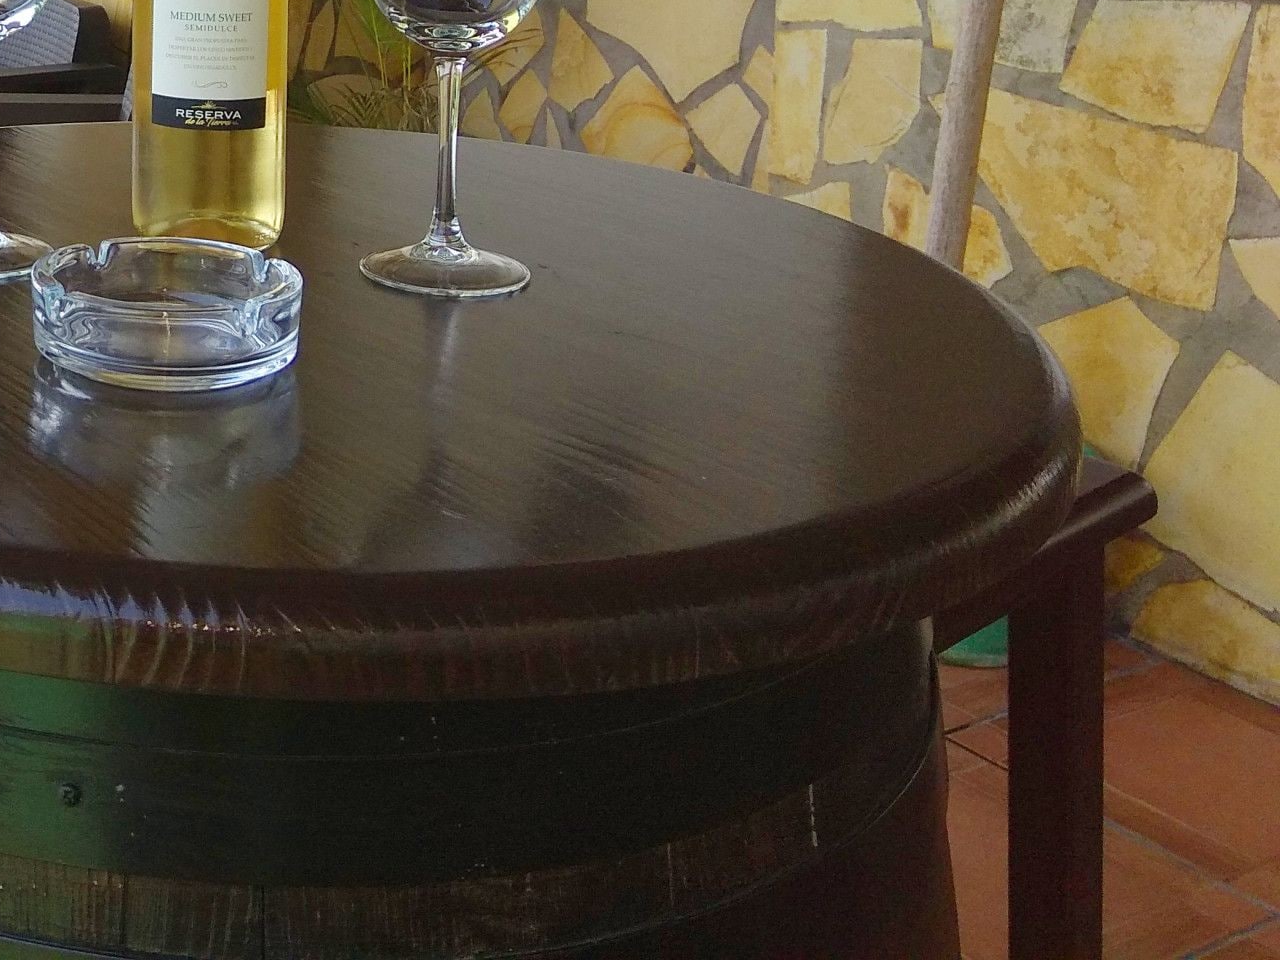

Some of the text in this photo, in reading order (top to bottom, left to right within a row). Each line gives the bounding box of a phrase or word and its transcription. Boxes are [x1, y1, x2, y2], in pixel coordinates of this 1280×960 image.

[170, 11, 253, 22] MEDIUM SWEET
[184, 24, 238, 32] SEMIDULCE
[175, 108, 241, 119] RESERVA
[185, 117, 195, 125] de
[205, 117, 231, 127] Tierra
